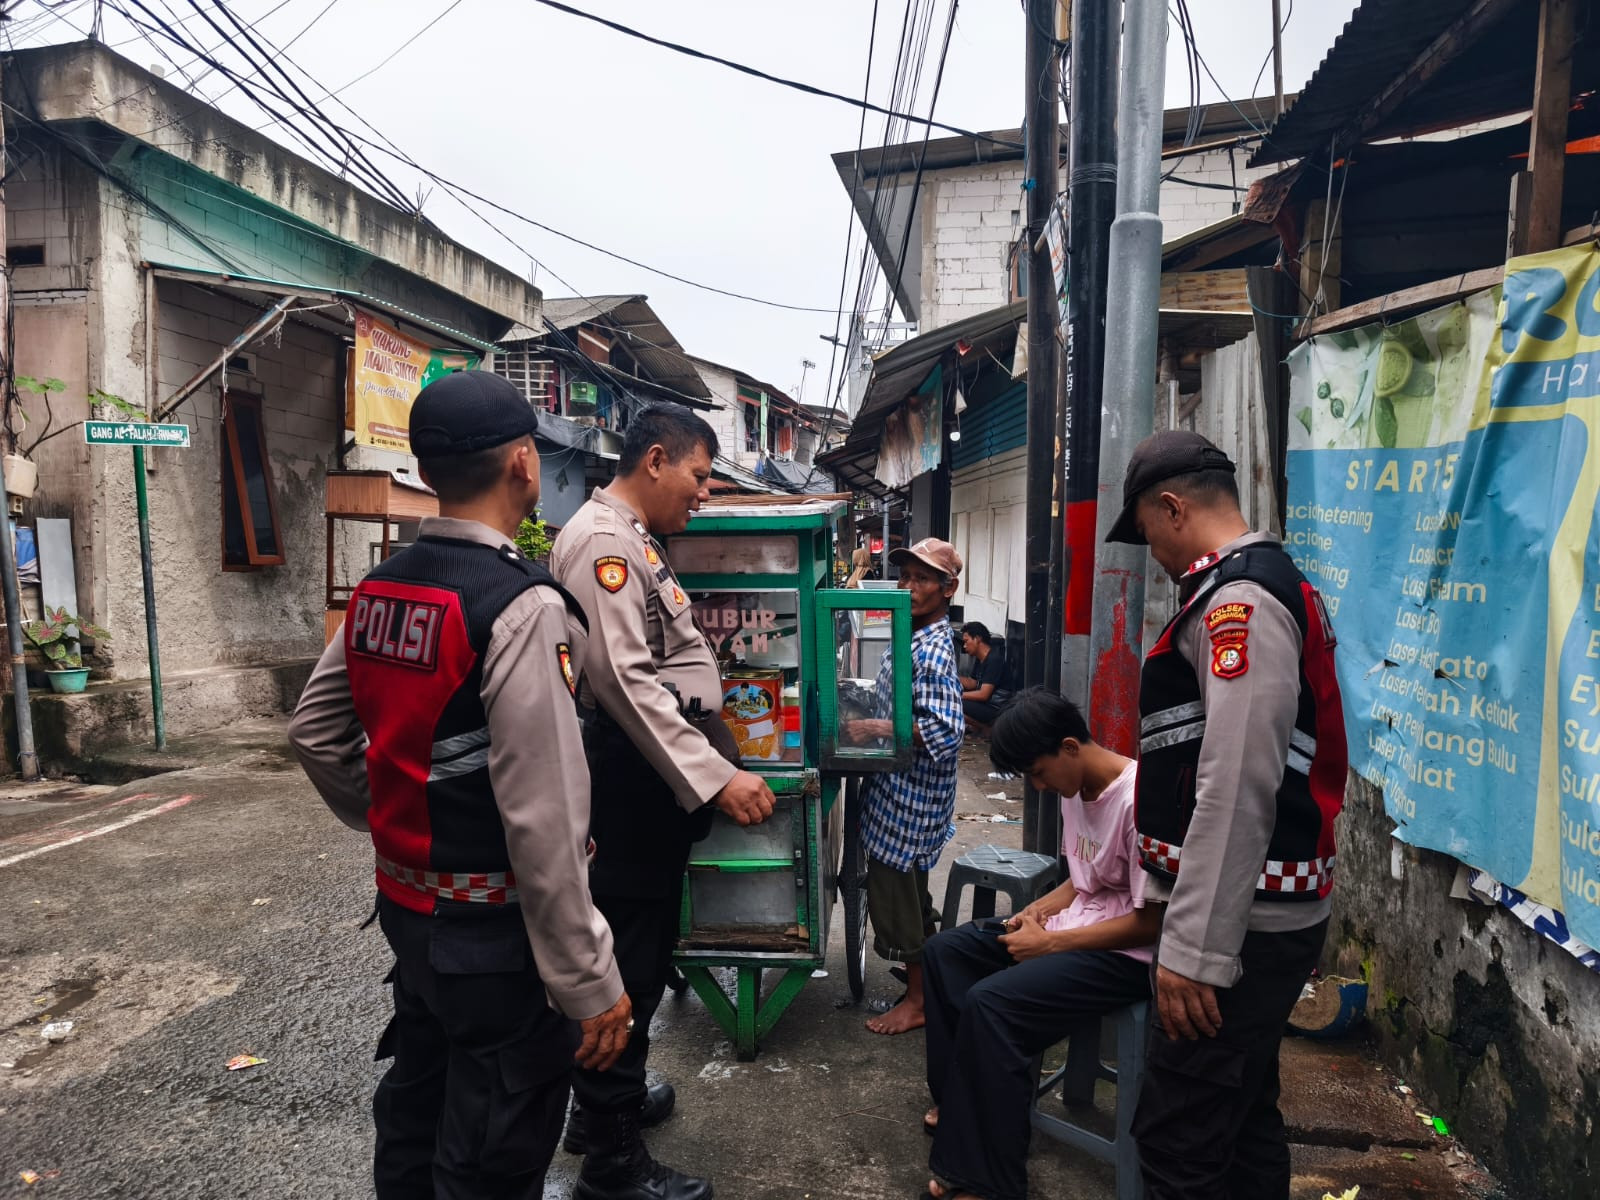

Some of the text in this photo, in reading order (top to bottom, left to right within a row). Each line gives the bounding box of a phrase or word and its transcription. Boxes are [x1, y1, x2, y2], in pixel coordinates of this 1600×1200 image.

[371, 328, 412, 360] WARUNG
[90, 426, 113, 439] GANG
[692, 608, 777, 629] UBUR
[1210, 604, 1246, 620] POLSEK
[1395, 606, 1427, 632] Laser
[351, 598, 436, 663] POLISI
[709, 632, 768, 654] YAM
[1388, 637, 1419, 665] Laser
[1379, 668, 1413, 697] Laser
[1470, 694, 1520, 734] Ketiak
[1368, 729, 1398, 762] Laser
[1487, 737, 1517, 775] Bulu
